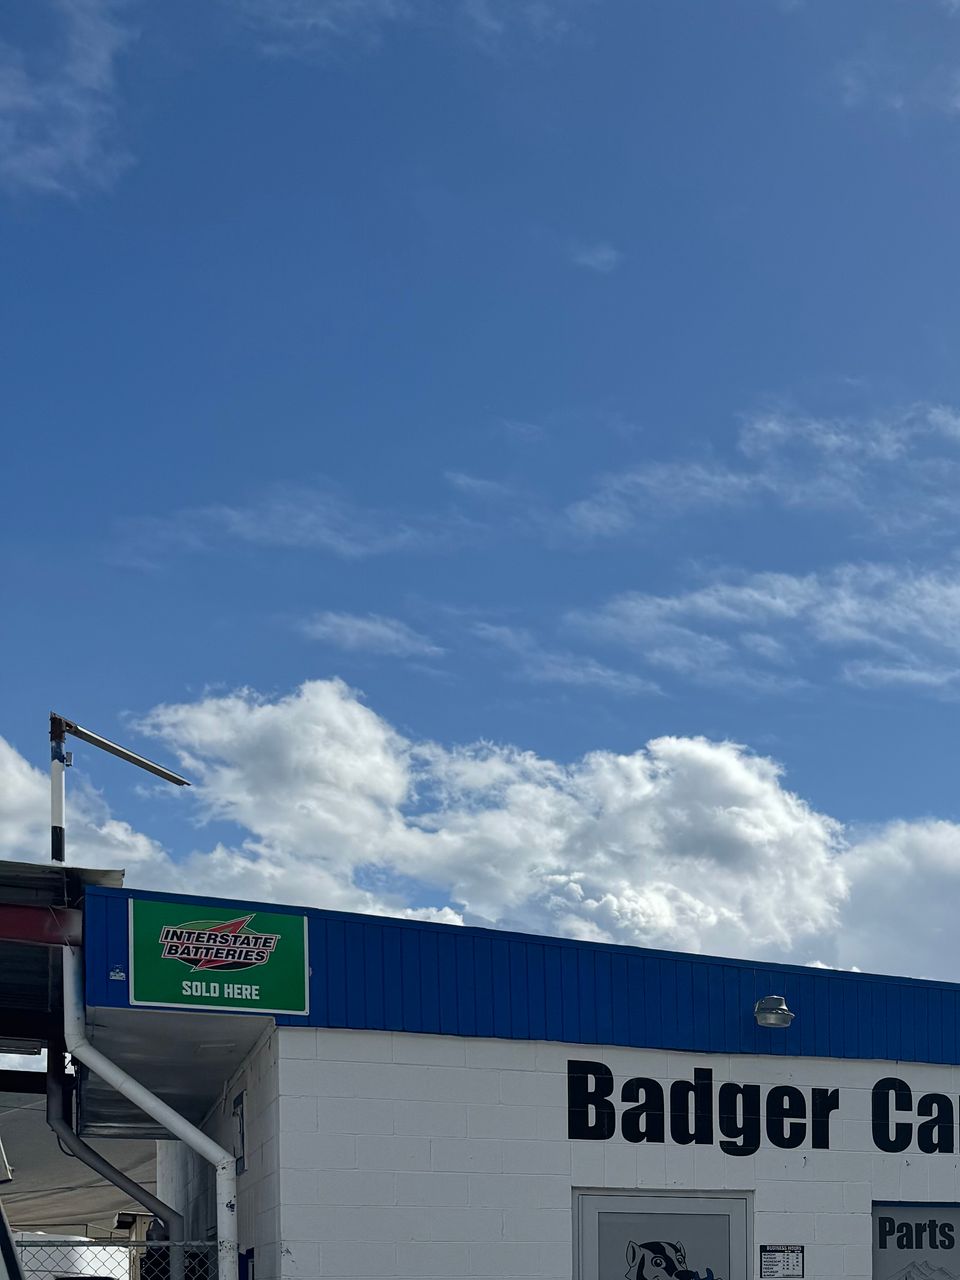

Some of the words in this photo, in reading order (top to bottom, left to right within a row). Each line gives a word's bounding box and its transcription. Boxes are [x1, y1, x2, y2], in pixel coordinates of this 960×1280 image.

[162, 929, 275, 949] INTERSTATE
[165, 943, 269, 962] BATTERIES
[182, 980, 220, 997] SOLD
[224, 983, 260, 999] HERE
[567, 1059, 840, 1157] Badger
[878, 1216, 955, 1250] Parts
